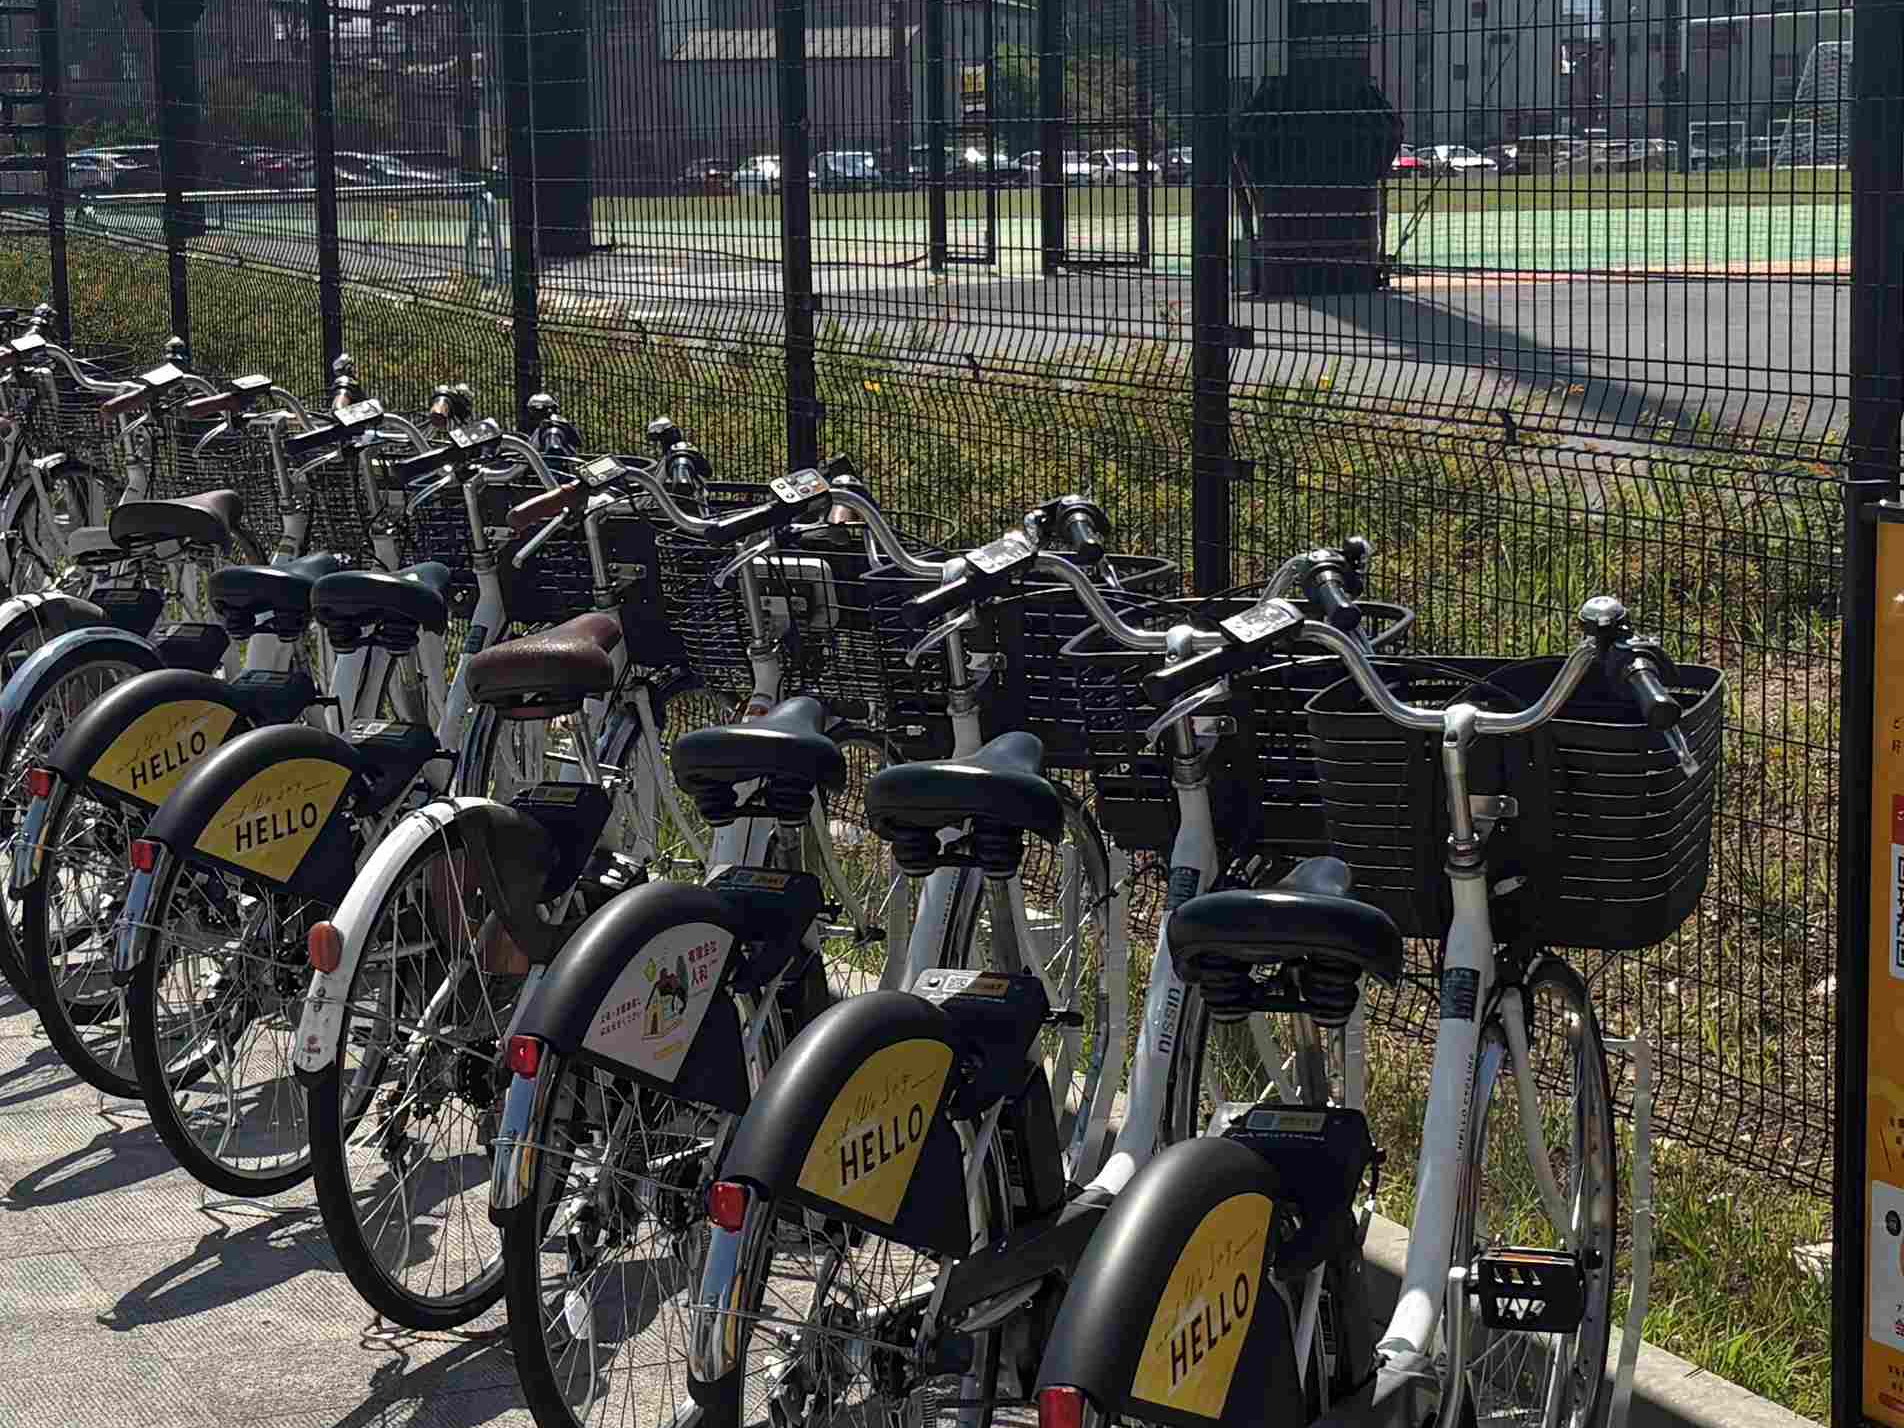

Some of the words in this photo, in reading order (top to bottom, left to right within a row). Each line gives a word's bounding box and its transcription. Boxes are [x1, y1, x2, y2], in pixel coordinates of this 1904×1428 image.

[131, 730, 206, 790] HELLO
[236, 802, 318, 852] HELLO
[840, 1102, 923, 1186] HELLO
[1171, 1272, 1250, 1387] HELLO
